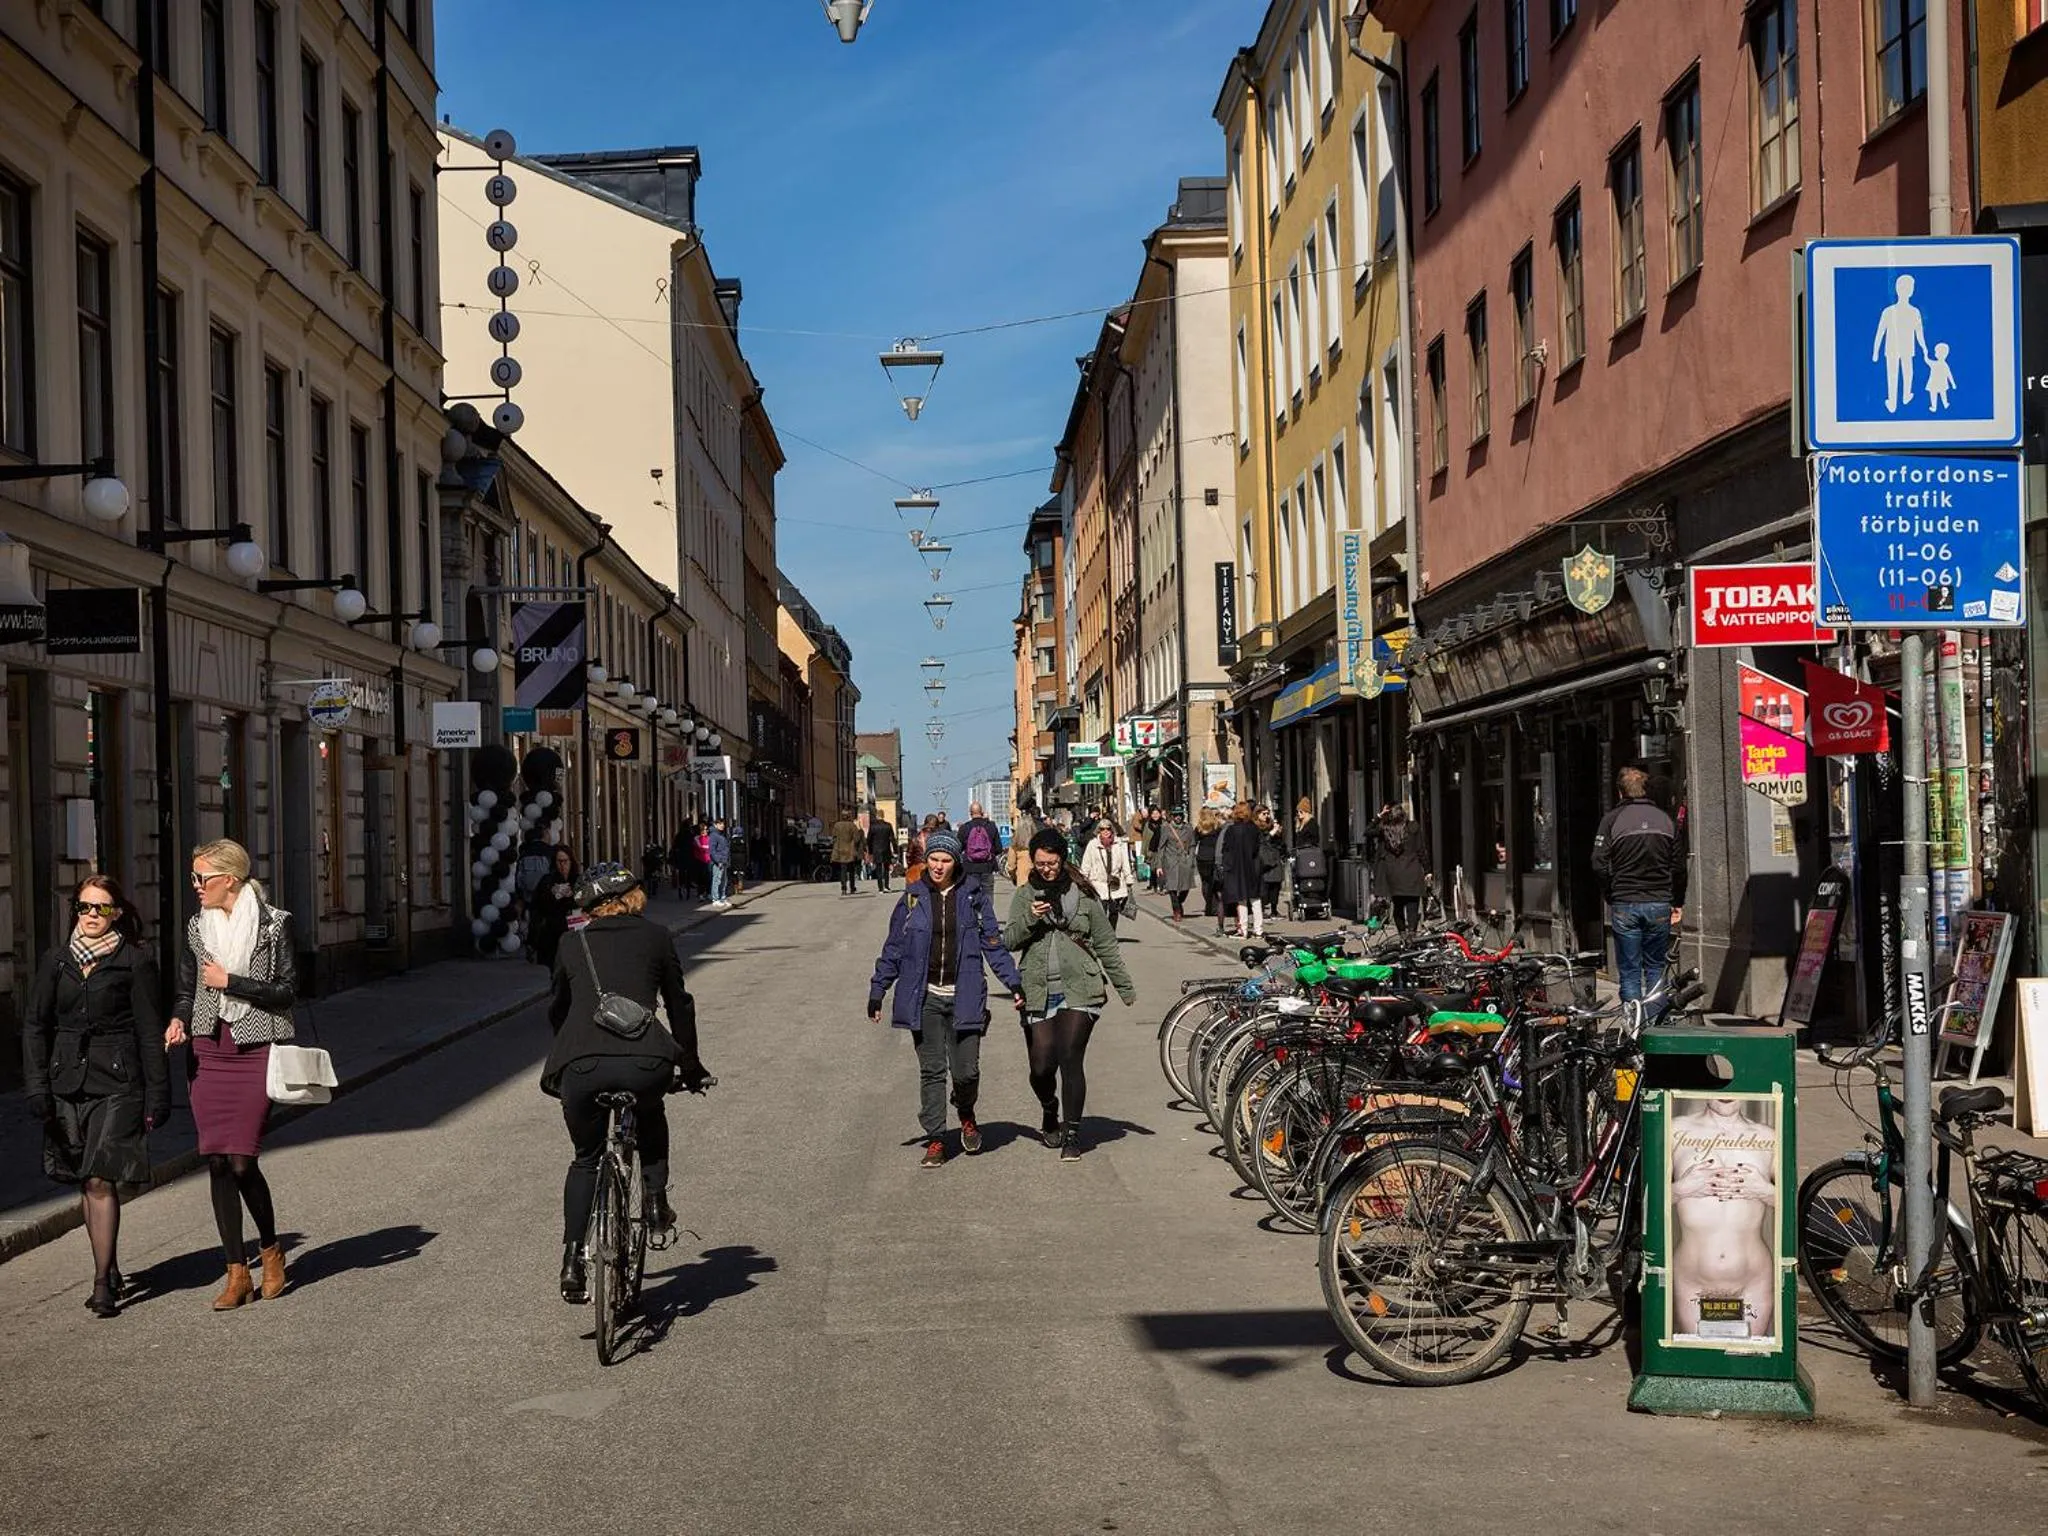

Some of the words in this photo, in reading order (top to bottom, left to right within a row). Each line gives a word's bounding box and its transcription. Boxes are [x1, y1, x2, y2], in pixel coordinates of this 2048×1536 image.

[490, 178, 513, 383] BRUNO
[1829, 466, 2008, 484] Motorfordons-
[1885, 491, 1952, 508] trafik
[1861, 515, 1979, 537] förbjuden
[1888, 543, 1951, 561] 11-06
[1879, 566, 1962, 588] (11-06)
[1705, 584, 1816, 608] TOBAK
[521, 647, 578, 662] BRUNO
[437, 728, 476, 736] American
[437, 736, 469, 745] Apparel
[1746, 746, 1787, 759] Tanka
[1747, 758, 1776, 774] här!
[1907, 974, 1927, 1033] MAKKS
